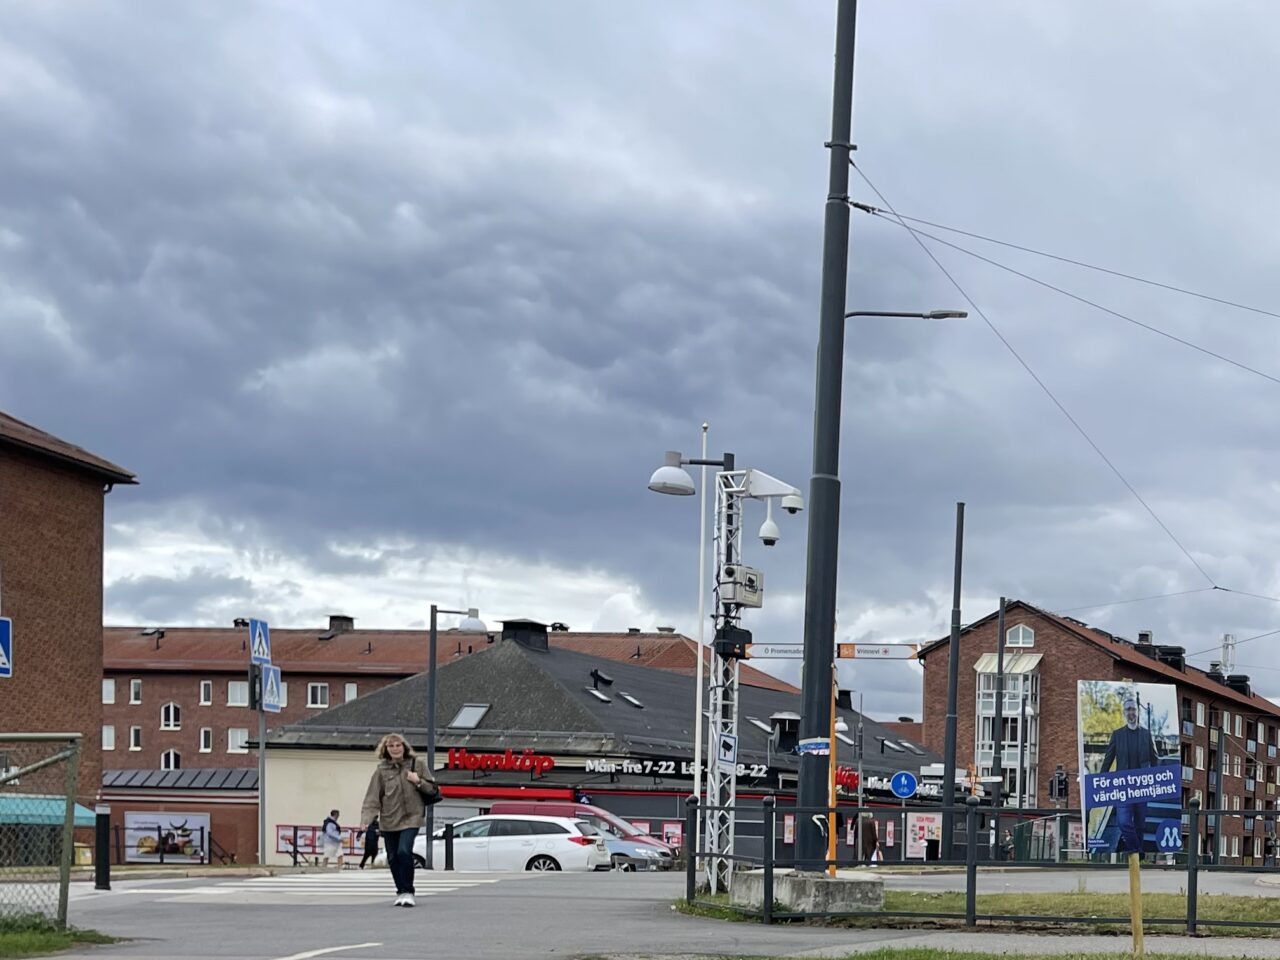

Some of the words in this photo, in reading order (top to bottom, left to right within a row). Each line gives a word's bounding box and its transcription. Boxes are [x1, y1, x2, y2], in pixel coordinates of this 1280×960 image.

[770, 647, 804, 655] Promenade
[448, 748, 555, 776] Hemköp
[585, 758, 642, 774] Mån-fre
[643, 761, 675, 774] 7-22
[1093, 776, 1110, 788] För
[1113, 777, 1126, 786] en
[1127, 774, 1154, 786] trygg
[1156, 770, 1173, 780] och
[1093, 789, 1127, 801] värdig
[1127, 783, 1176, 798] hemtjänst
